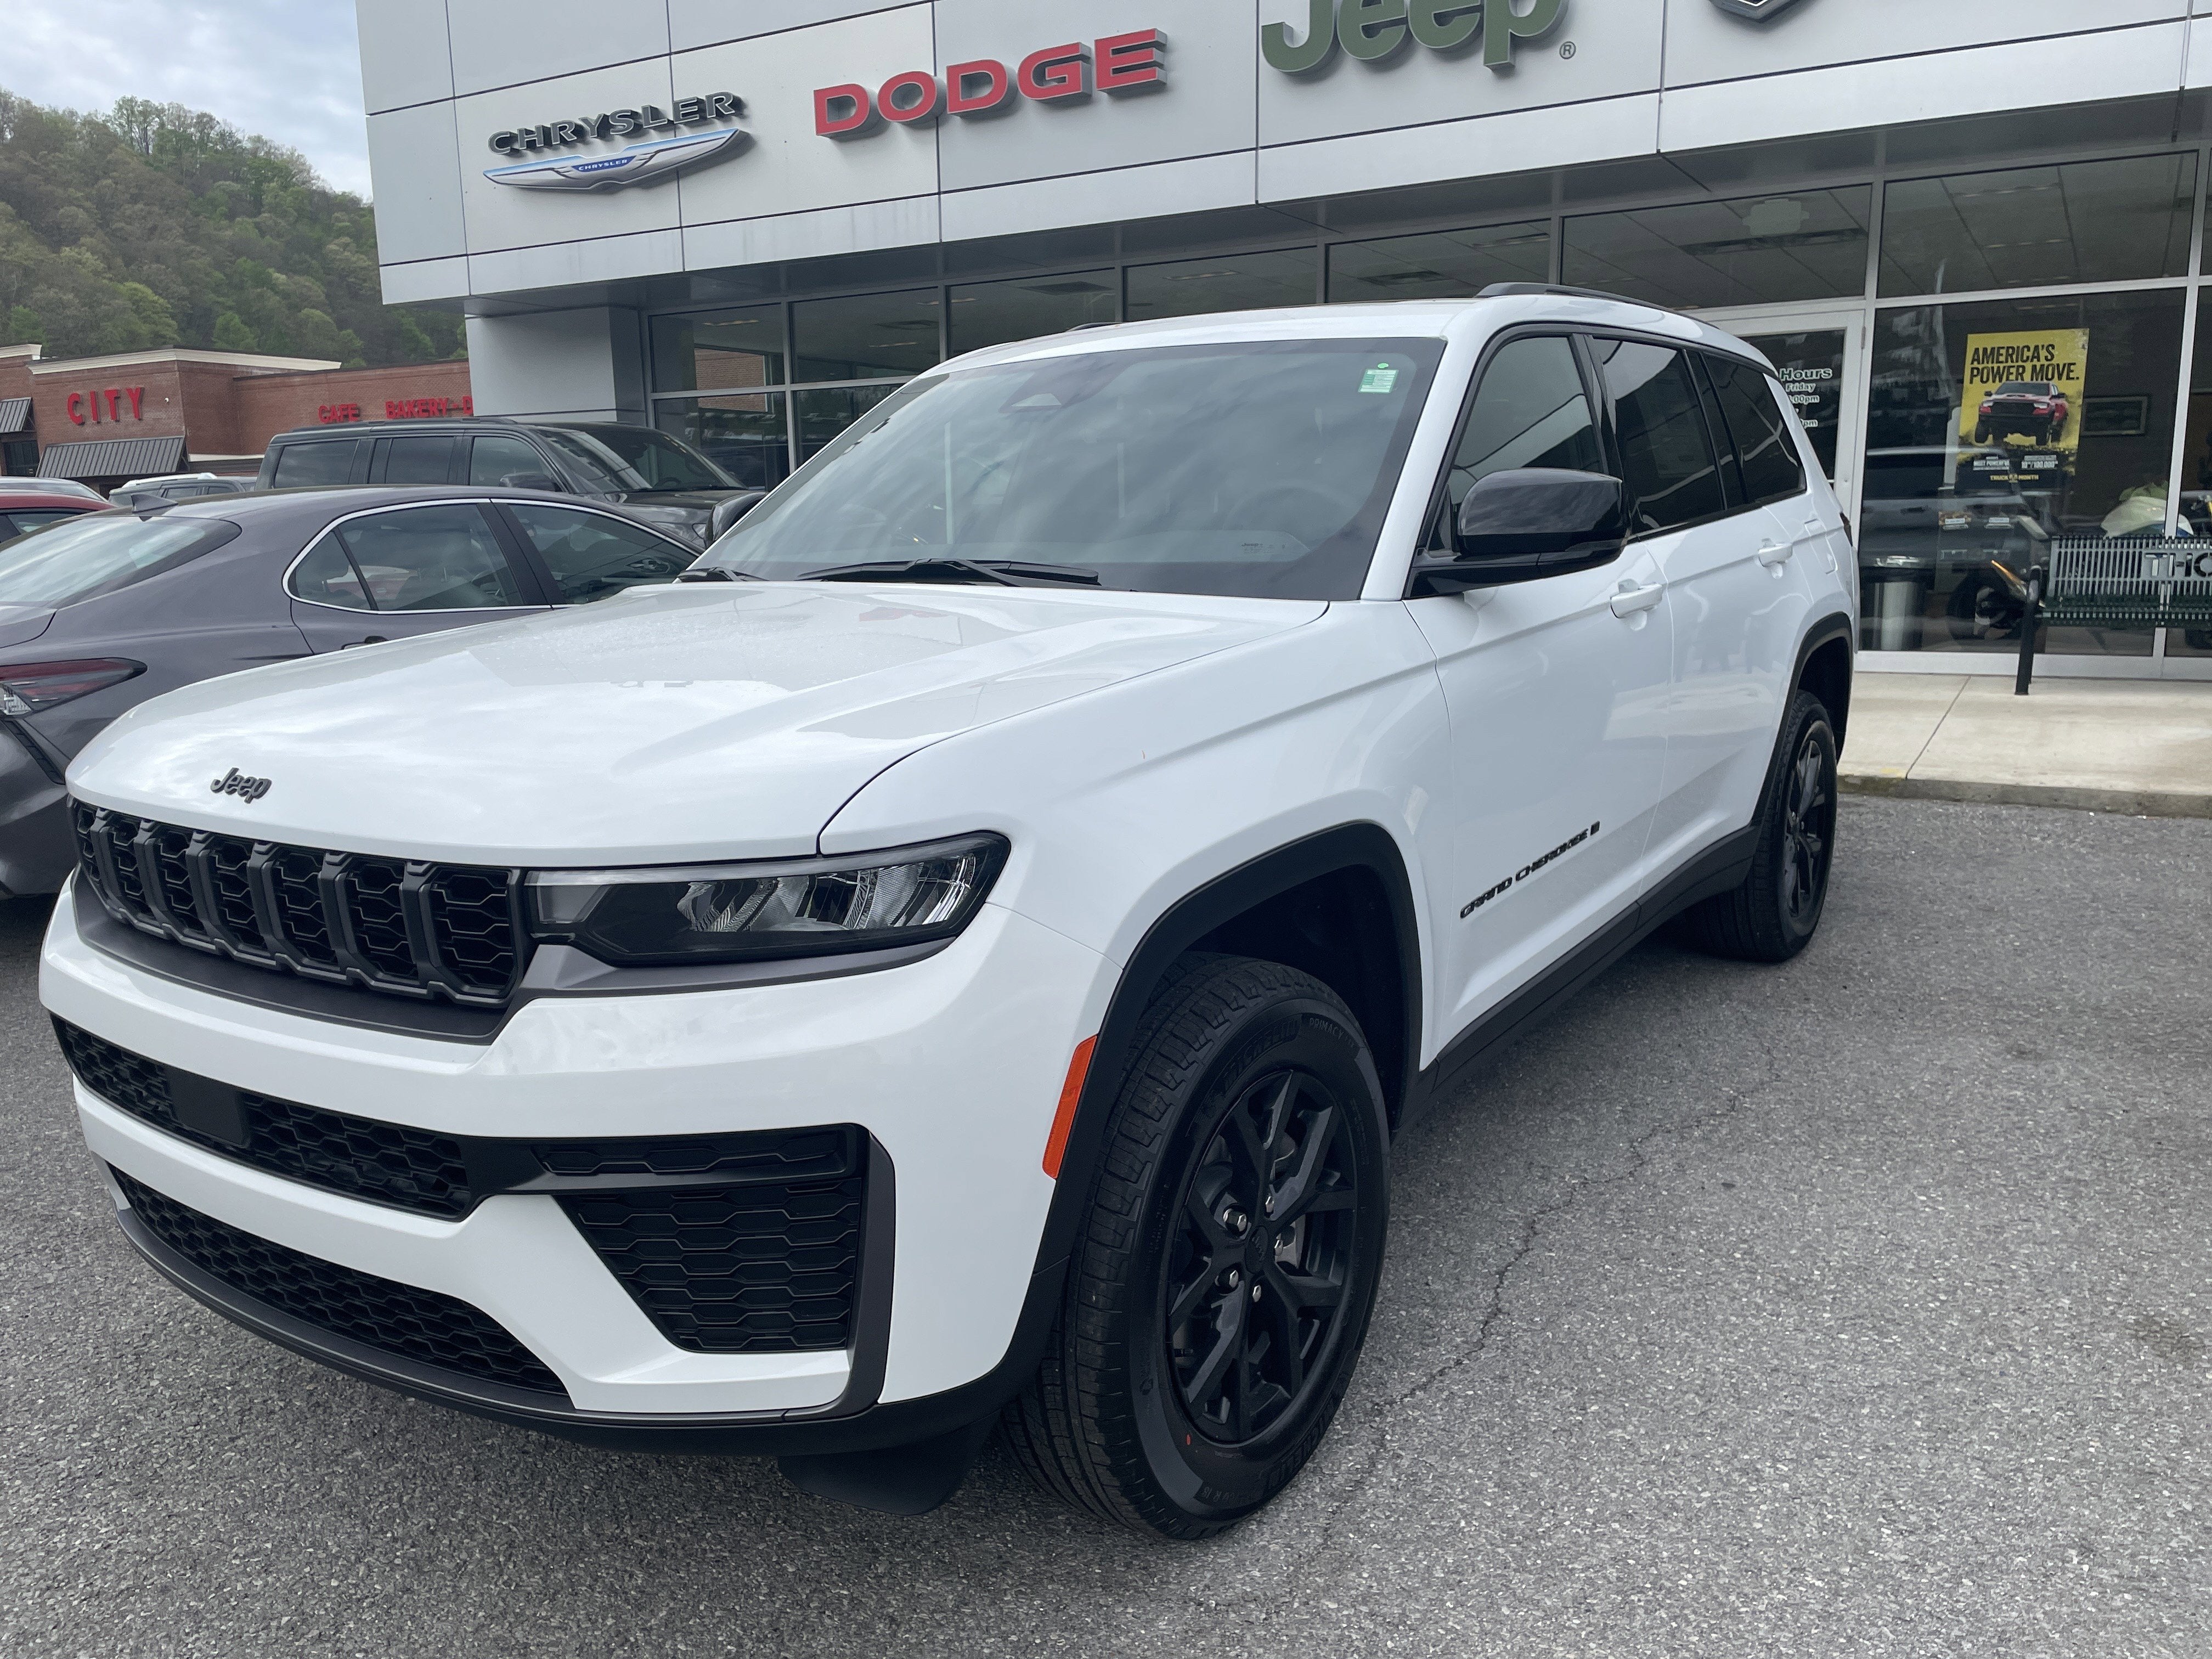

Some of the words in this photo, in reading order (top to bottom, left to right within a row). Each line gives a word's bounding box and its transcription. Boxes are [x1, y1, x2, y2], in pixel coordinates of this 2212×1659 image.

[814, 27, 1166, 136] DODGE
[488, 90, 738, 155] CHRYSLER
[578, 158, 629, 172] CHRYSLER
[1970, 343, 2055, 365] AMERICA'S
[1779, 368, 1833, 381] Hours
[1969, 364, 2026, 385] POWER
[2029, 362, 2080, 382] MOVE.
[1785, 382, 1816, 393] Friday
[67, 387, 144, 425] CITY
[318, 403, 359, 424] CAFE
[210, 767, 273, 804] Jeep
